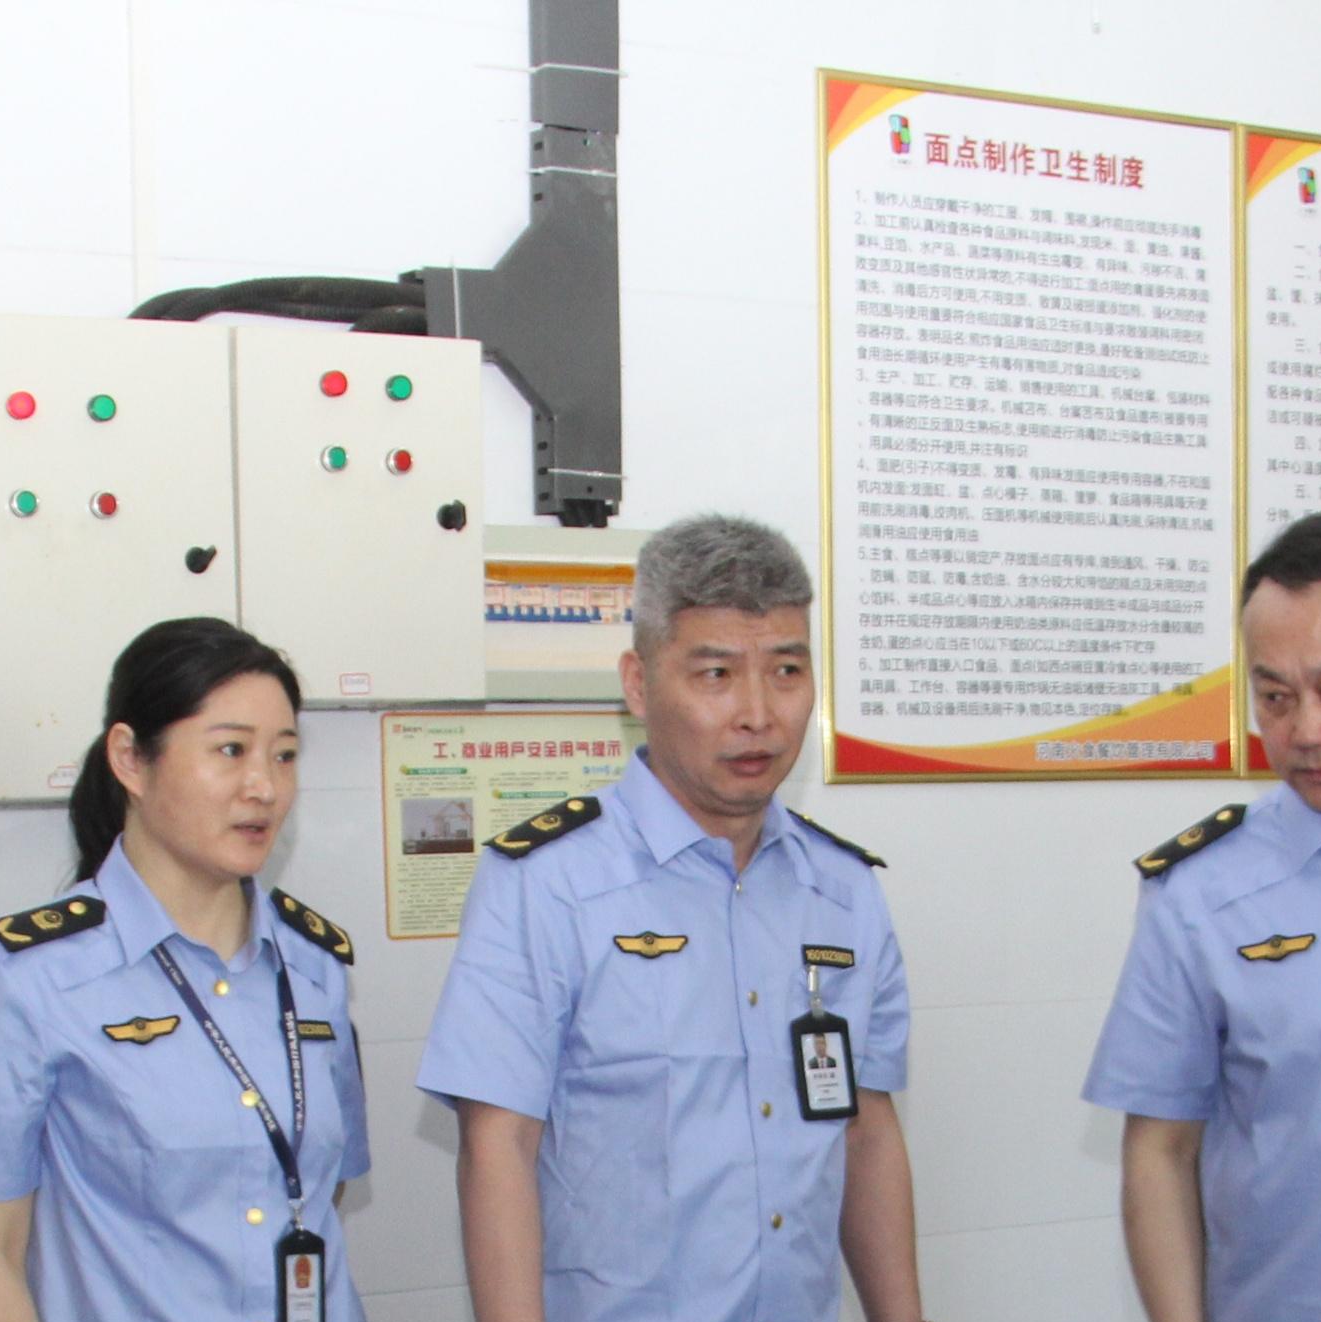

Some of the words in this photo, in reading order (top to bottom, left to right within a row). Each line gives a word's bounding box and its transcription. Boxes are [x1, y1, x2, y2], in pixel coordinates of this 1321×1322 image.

[924, 132, 1144, 189] 面点制作卫生制度
[433, 740, 622, 760] 工、商业用户安全用气提示
